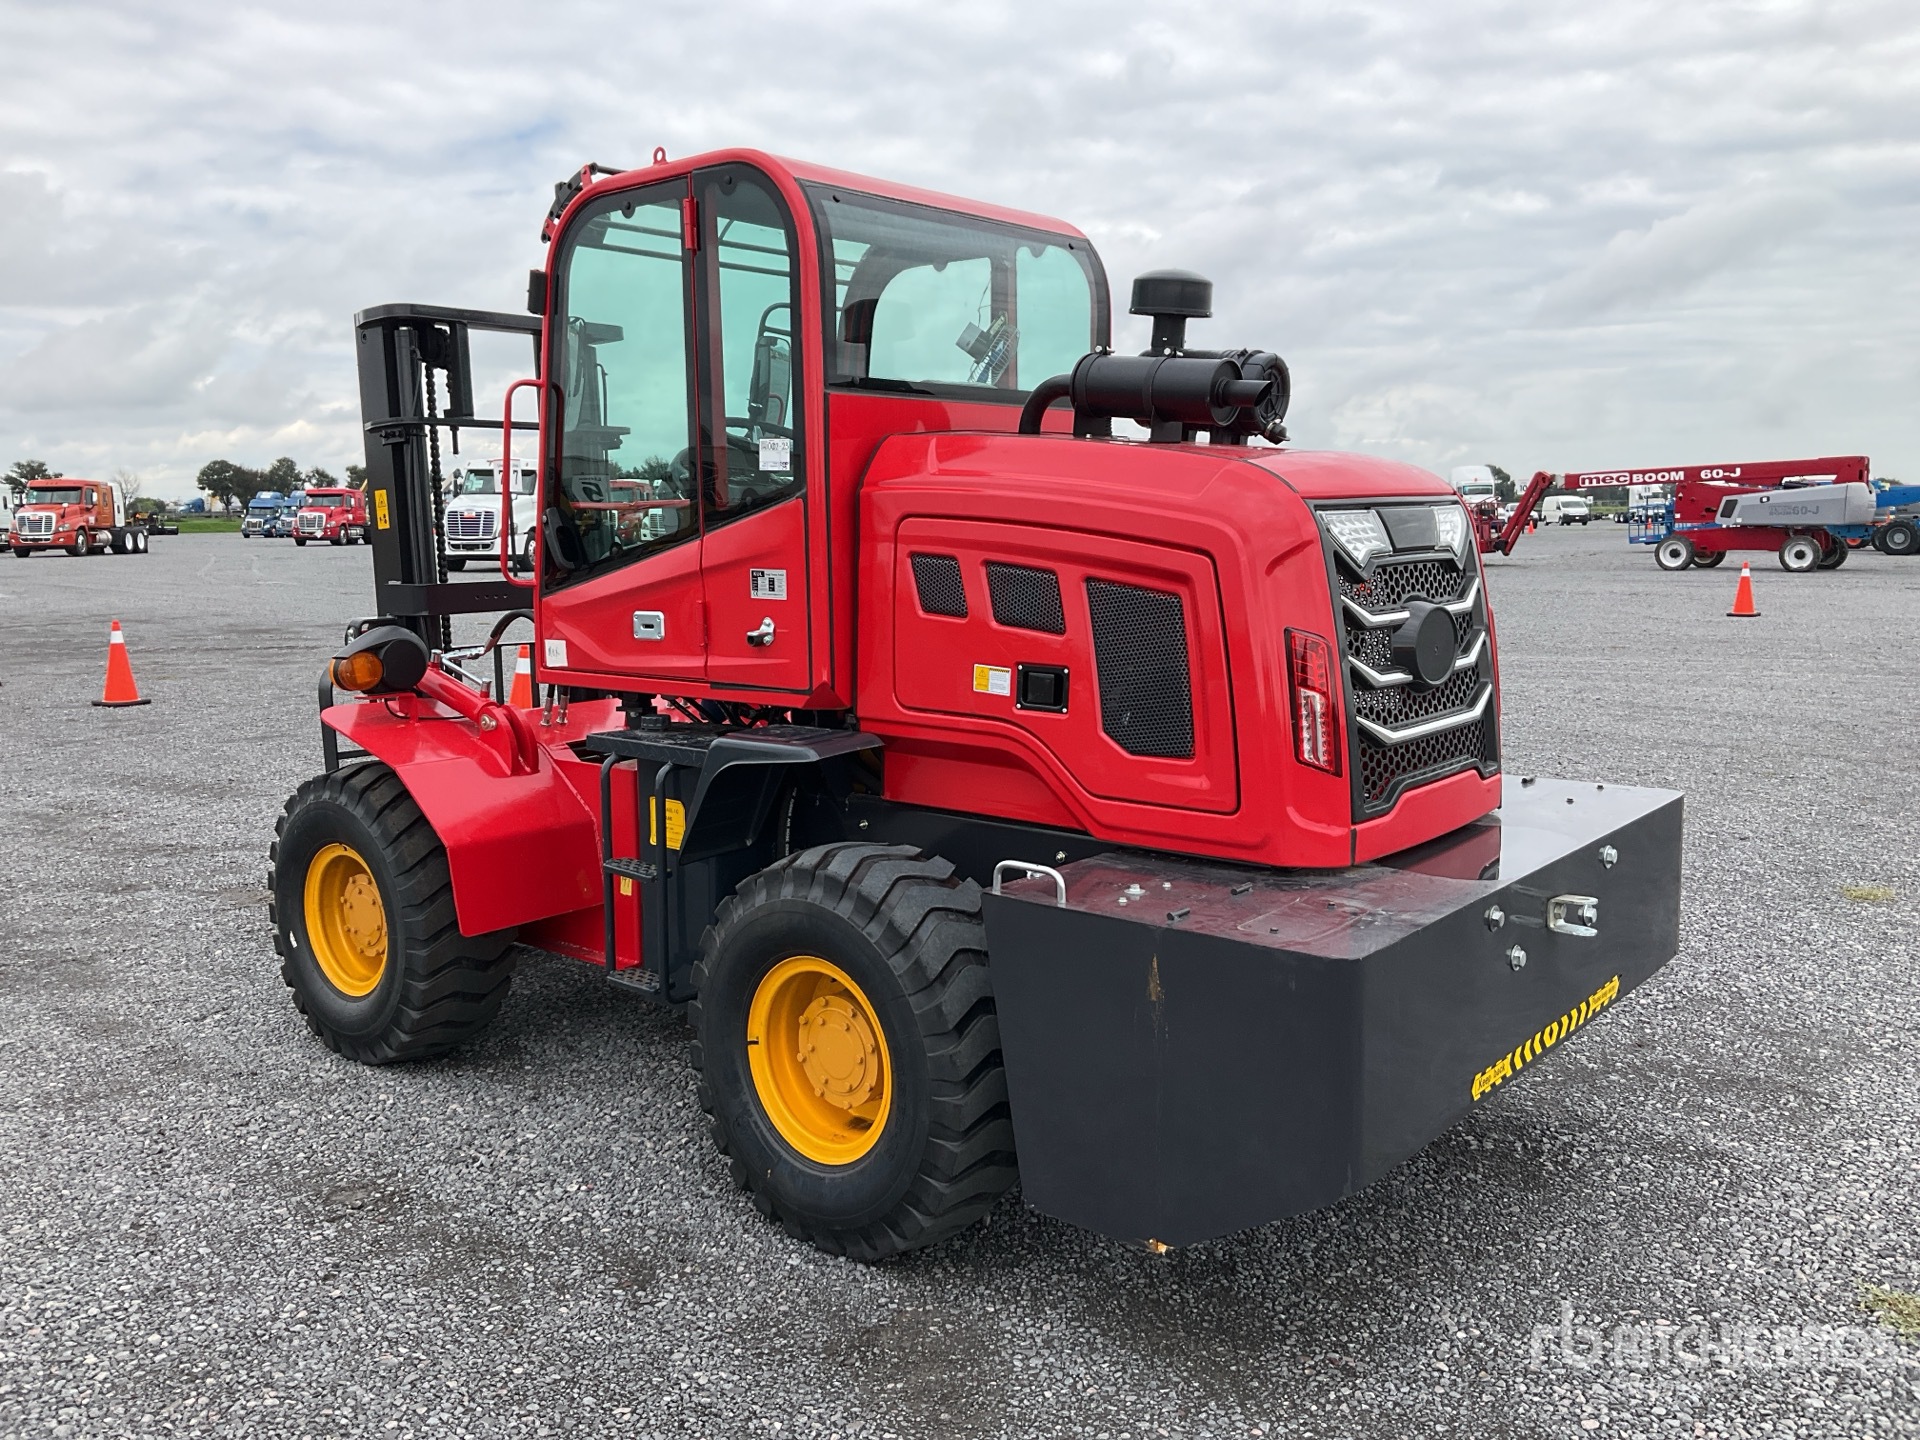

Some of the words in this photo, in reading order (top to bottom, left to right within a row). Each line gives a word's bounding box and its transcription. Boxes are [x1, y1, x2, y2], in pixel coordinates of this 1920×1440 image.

[1580, 473, 1629, 486] mec
[1632, 470, 1684, 483] BOOM
[1700, 467, 1741, 479] 60-J
[1792, 505, 1820, 515] 60-J
